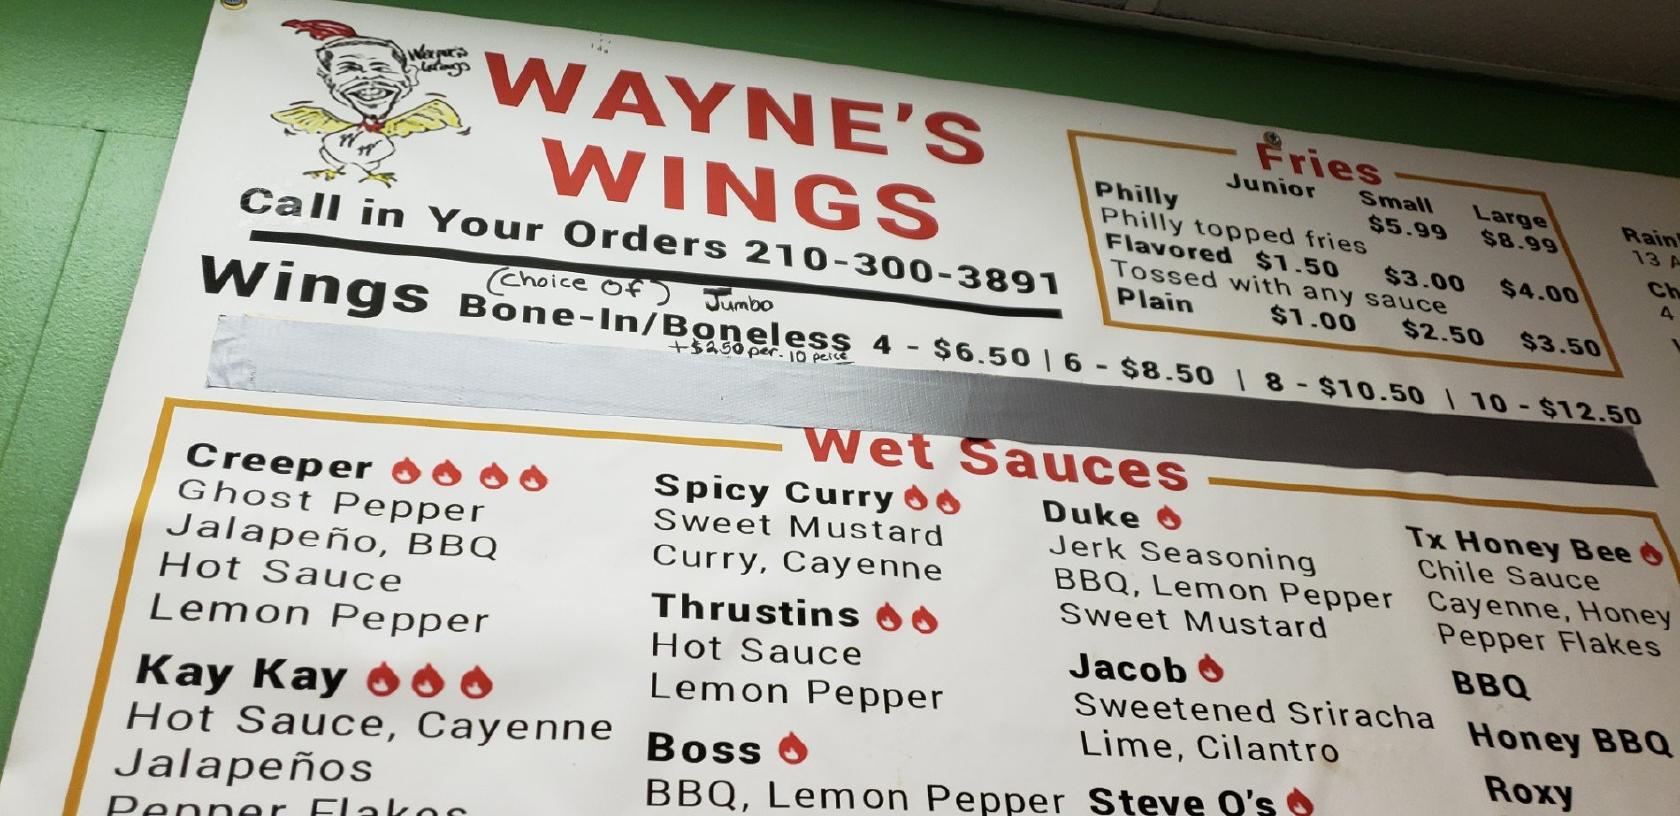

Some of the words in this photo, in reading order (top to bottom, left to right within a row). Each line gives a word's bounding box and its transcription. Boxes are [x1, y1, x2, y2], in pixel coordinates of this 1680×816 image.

[484, 51, 985, 165] WAYNE'S
[1255, 141, 1382, 187] Fries
[542, 137, 939, 240] WINGS
[1226, 173, 1315, 198] Junior
[1359, 190, 1433, 214] Small
[1473, 205, 1547, 230] Large
[1095, 181, 1178, 211] Philly
[1368, 214, 1447, 240] $5.99
[1481, 229, 1558, 254] $8.99
[1101, 206, 1183, 237] Philly
[1194, 219, 1295, 245] topped
[1305, 230, 1367, 255] fries
[1621, 226, 1680, 248] Rain
[240, 187, 341, 221] Call
[361, 198, 404, 228] in
[428, 205, 544, 241] Your
[564, 220, 726, 259] Orders
[745, 240, 1058, 295] 210-300-3891
[1632, 250, 1661, 267] 13
[201, 255, 429, 318] Wings
[1105, 231, 1233, 266] Flavored
[1253, 250, 1339, 279] $1.50
[1384, 265, 1465, 292] $3.00
[1500, 278, 1579, 304] $4.00
[1110, 258, 1218, 289] Tossed
[1229, 275, 1291, 296] with
[1303, 286, 1353, 307] any
[1365, 293, 1447, 314] sauce
[702, 285, 776, 314] Jumbo
[1117, 287, 1193, 313] Plain
[1271, 304, 1356, 332] $1.00
[1402, 318, 1484, 346] $2.50
[1518, 329, 1602, 359] $3.50
[459, 293, 851, 351] Bone-In/Boneless
[873, 334, 891, 355] 4
[934, 337, 1030, 366] $6.50
[1064, 352, 1082, 372] 6
[1121, 356, 1214, 385] $8.50
[1265, 372, 1283, 391] 8
[1319, 376, 1424, 404] $10.50
[1471, 392, 1507, 412] 10
[1539, 397, 1642, 425] $12.50
[187, 443, 373, 482] Creeper
[803, 427, 935, 472] Wet
[959, 436, 1190, 492] Sauces
[179, 479, 311, 511] Ghost
[333, 491, 485, 525] Pepper
[654, 473, 769, 508] Spicy
[785, 481, 893, 514] Curry
[654, 508, 771, 536] Sweet
[790, 515, 943, 547] Mustard
[1043, 500, 1140, 529] Duke
[166, 513, 386, 558] Jalapeño,
[408, 532, 497, 561] BBQ
[1049, 535, 1126, 560] Jerk
[1141, 541, 1316, 577] Seasoning
[1405, 525, 1447, 550] Tx
[1455, 530, 1559, 564] Honey
[1570, 538, 1632, 563] Bee
[159, 551, 241, 580] Hot
[263, 559, 401, 592] Sauce
[653, 544, 766, 575] Curry,
[783, 550, 942, 581] Cayenne
[1418, 559, 1494, 584] Chile
[1506, 566, 1600, 591] Sauce
[651, 592, 859, 627] Thrustins
[1054, 567, 1139, 598] BBQ,
[1152, 574, 1267, 602] Lemon
[1280, 582, 1393, 612] Pepper
[150, 593, 309, 626] Lemon
[331, 603, 490, 638] Pepper
[1060, 602, 1169, 630] Sweet
[1184, 609, 1327, 639] Mustard
[1427, 591, 1570, 623] Cayenne,
[1577, 600, 1670, 631] Honey
[652, 632, 721, 661] Hot
[741, 637, 861, 666] Sauce
[1437, 622, 1545, 653] Pepper
[1558, 630, 1661, 657] Flakes
[136, 654, 234, 696] Kay
[253, 658, 348, 699] Kay
[1069, 653, 1187, 683] Jacob
[1451, 670, 1532, 702] BBQ
[651, 672, 788, 704] Lemon
[808, 679, 943, 714] Pepper
[1074, 692, 1275, 723] Sweetened
[1288, 700, 1435, 729] Sriracha
[126, 701, 214, 732] Hot
[236, 705, 396, 744] Sauce,
[418, 711, 612, 746] Cayenne
[1467, 721, 1580, 759] Honey
[1592, 728, 1674, 759] BBQ
[647, 731, 761, 765] Boss
[1080, 729, 1183, 763] Lime,
[1192, 733, 1340, 764] Cilantro
[114, 748, 372, 786] Jalapeños
[646, 778, 749, 813] BBQ,
[769, 781, 908, 811] Lemon
[927, 784, 1065, 816] Pepper
[1089, 787, 1204, 816] Steve
[1218, 789, 1276, 816] O's
[1484, 775, 1572, 813] Roxy
